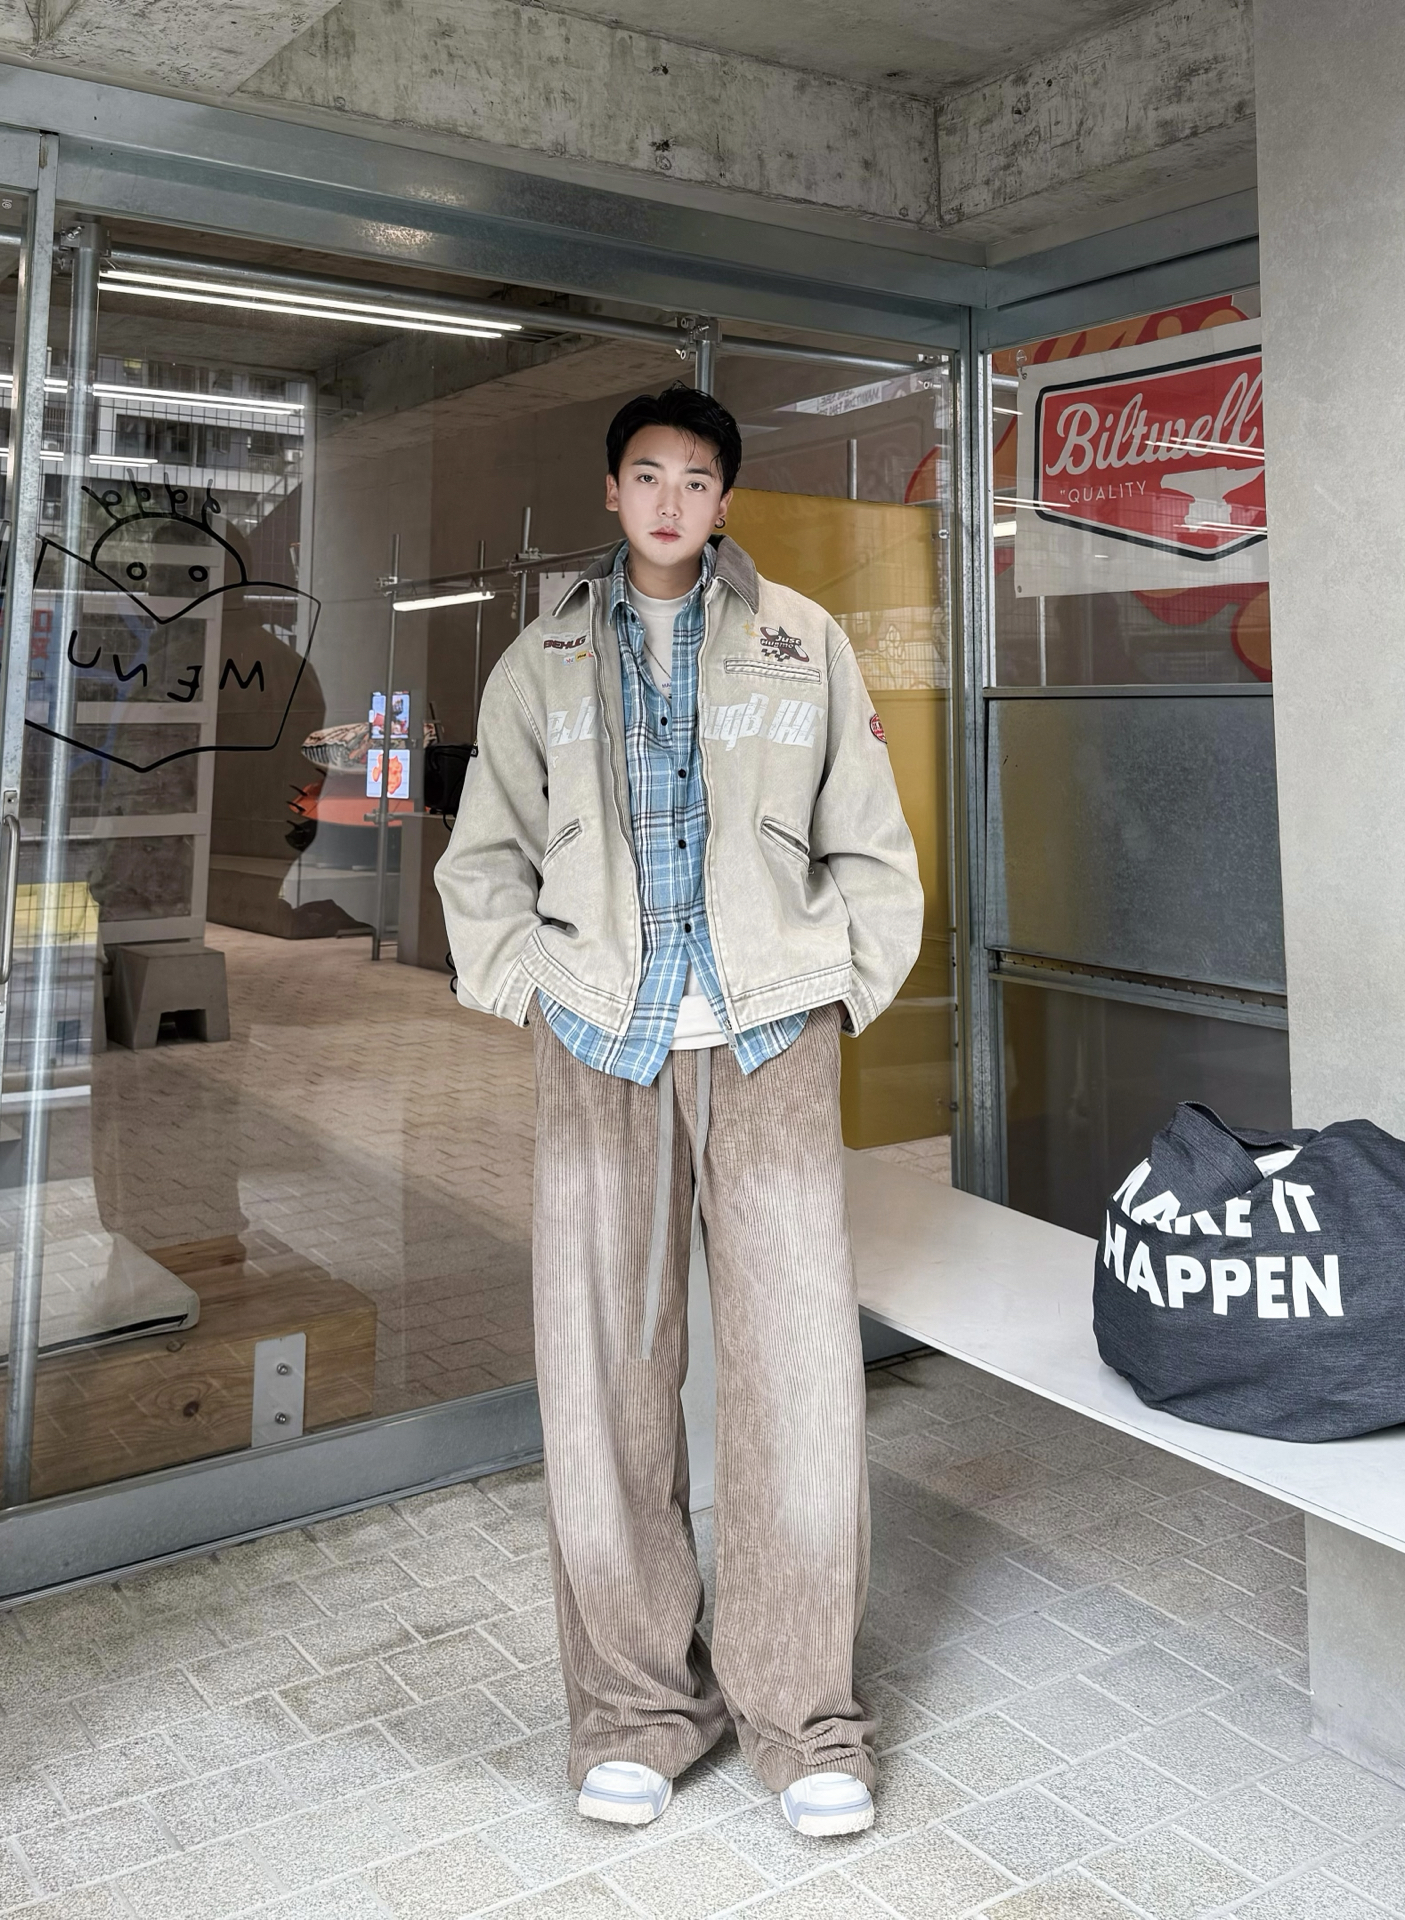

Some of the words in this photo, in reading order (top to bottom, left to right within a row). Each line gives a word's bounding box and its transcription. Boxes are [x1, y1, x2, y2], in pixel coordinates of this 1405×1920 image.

[1045, 372, 1262, 476] Biltwell
[1272, 1178, 1321, 1234] IT
[1103, 1209, 1345, 1319] HAPPEN
